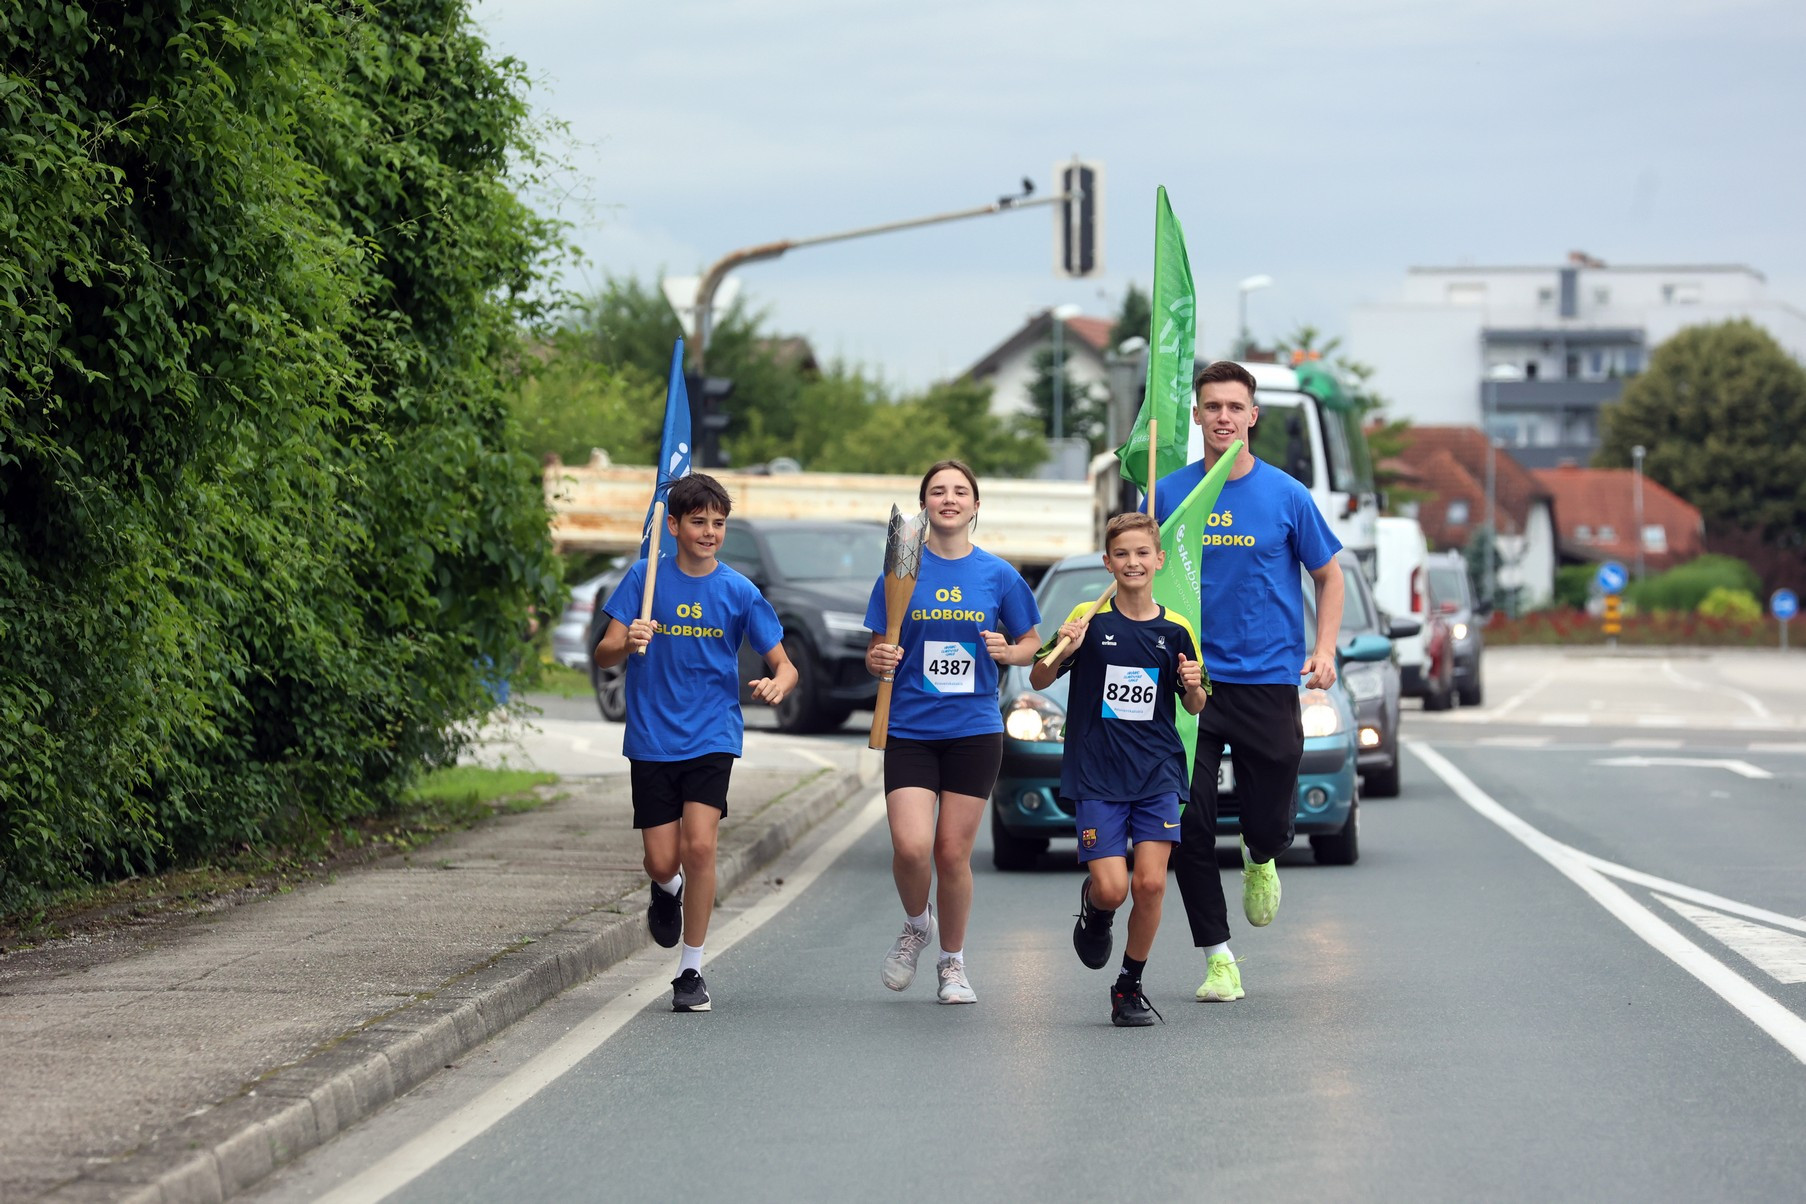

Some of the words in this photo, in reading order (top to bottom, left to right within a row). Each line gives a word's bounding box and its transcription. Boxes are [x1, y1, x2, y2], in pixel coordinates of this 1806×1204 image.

[1206, 510, 1233, 527] OŠ
[1202, 534, 1256, 547] OBOKO
[1177, 543, 1201, 604] skbban
[936, 586, 962, 603] OŠ
[676, 602, 703, 619] OŠ
[911, 608, 985, 622] GLOBOKO
[654, 623, 724, 638] GLOBOKO
[928, 659, 971, 676] 4387
[1106, 682, 1154, 704] 8286
